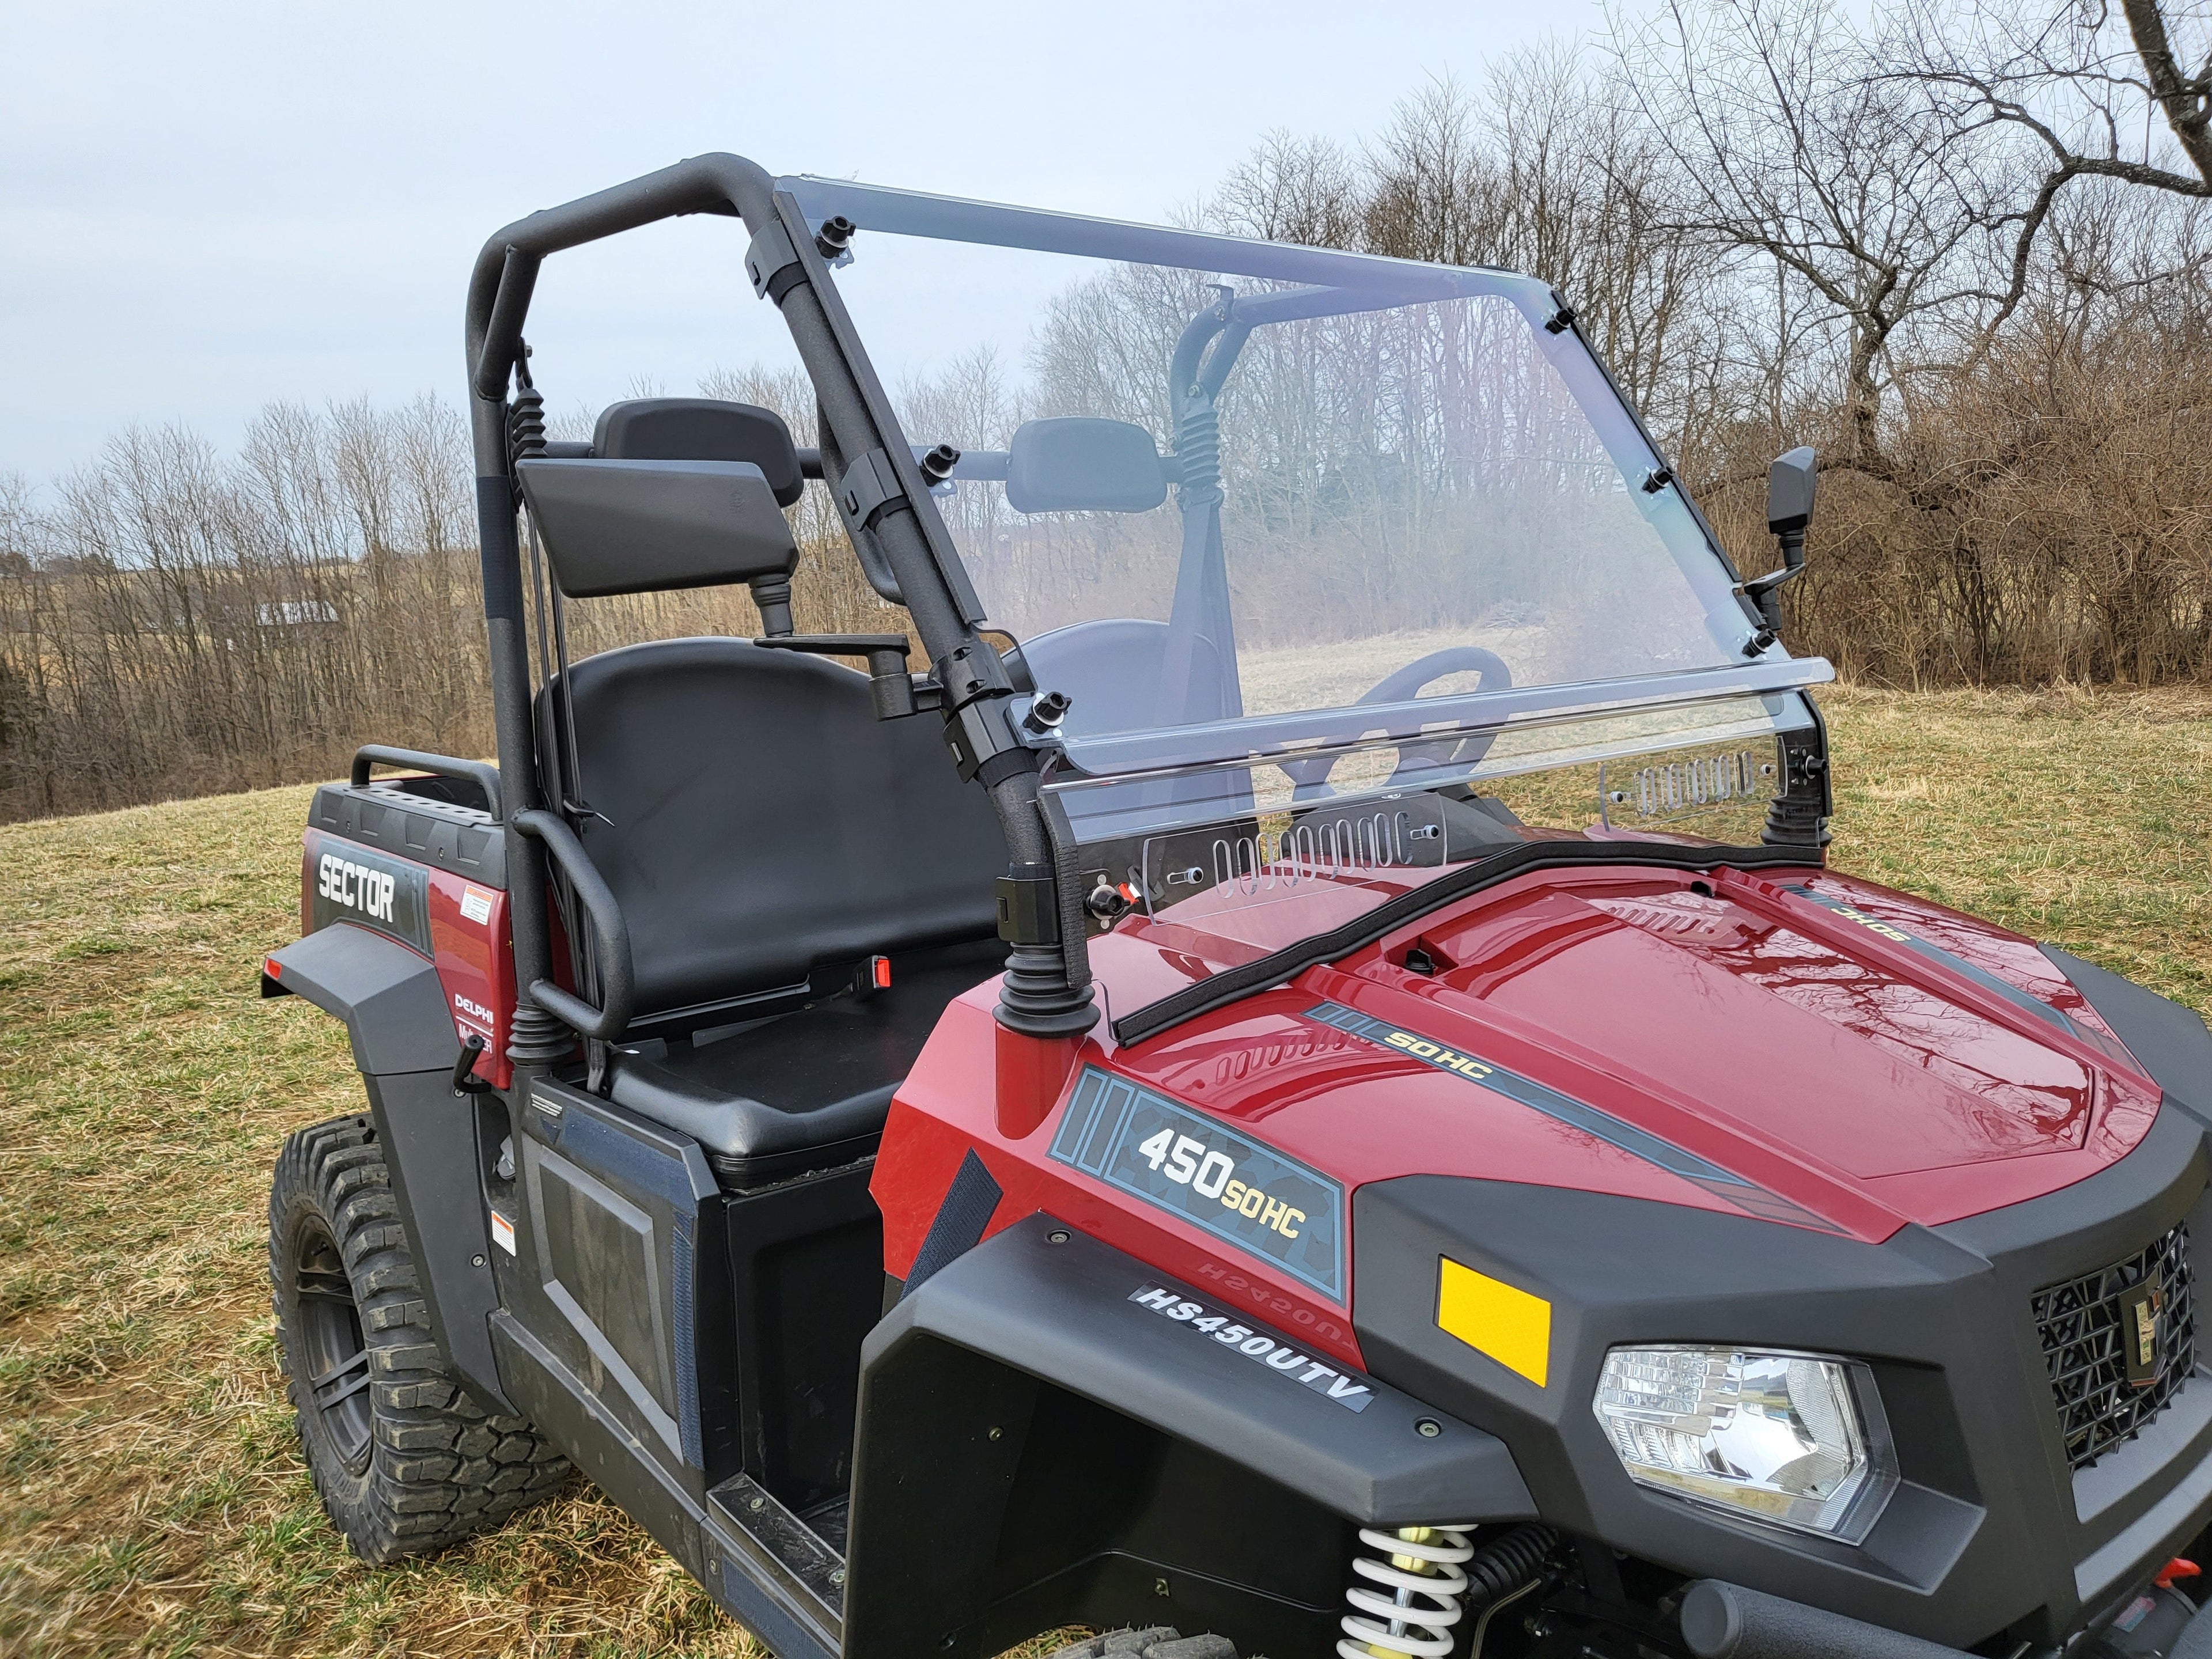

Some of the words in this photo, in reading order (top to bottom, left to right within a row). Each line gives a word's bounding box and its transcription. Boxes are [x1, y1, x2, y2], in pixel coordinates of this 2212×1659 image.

[319, 853, 395, 923] SECTOR
[1830, 907, 1912, 942] SOHC
[454, 993, 494, 1024] DELPHI
[1384, 1032, 1493, 1079] SOHC
[1138, 1128, 1235, 1199] 450
[1221, 1179, 1306, 1238] SOHC
[1136, 1288, 1370, 1398] HS450UTV
